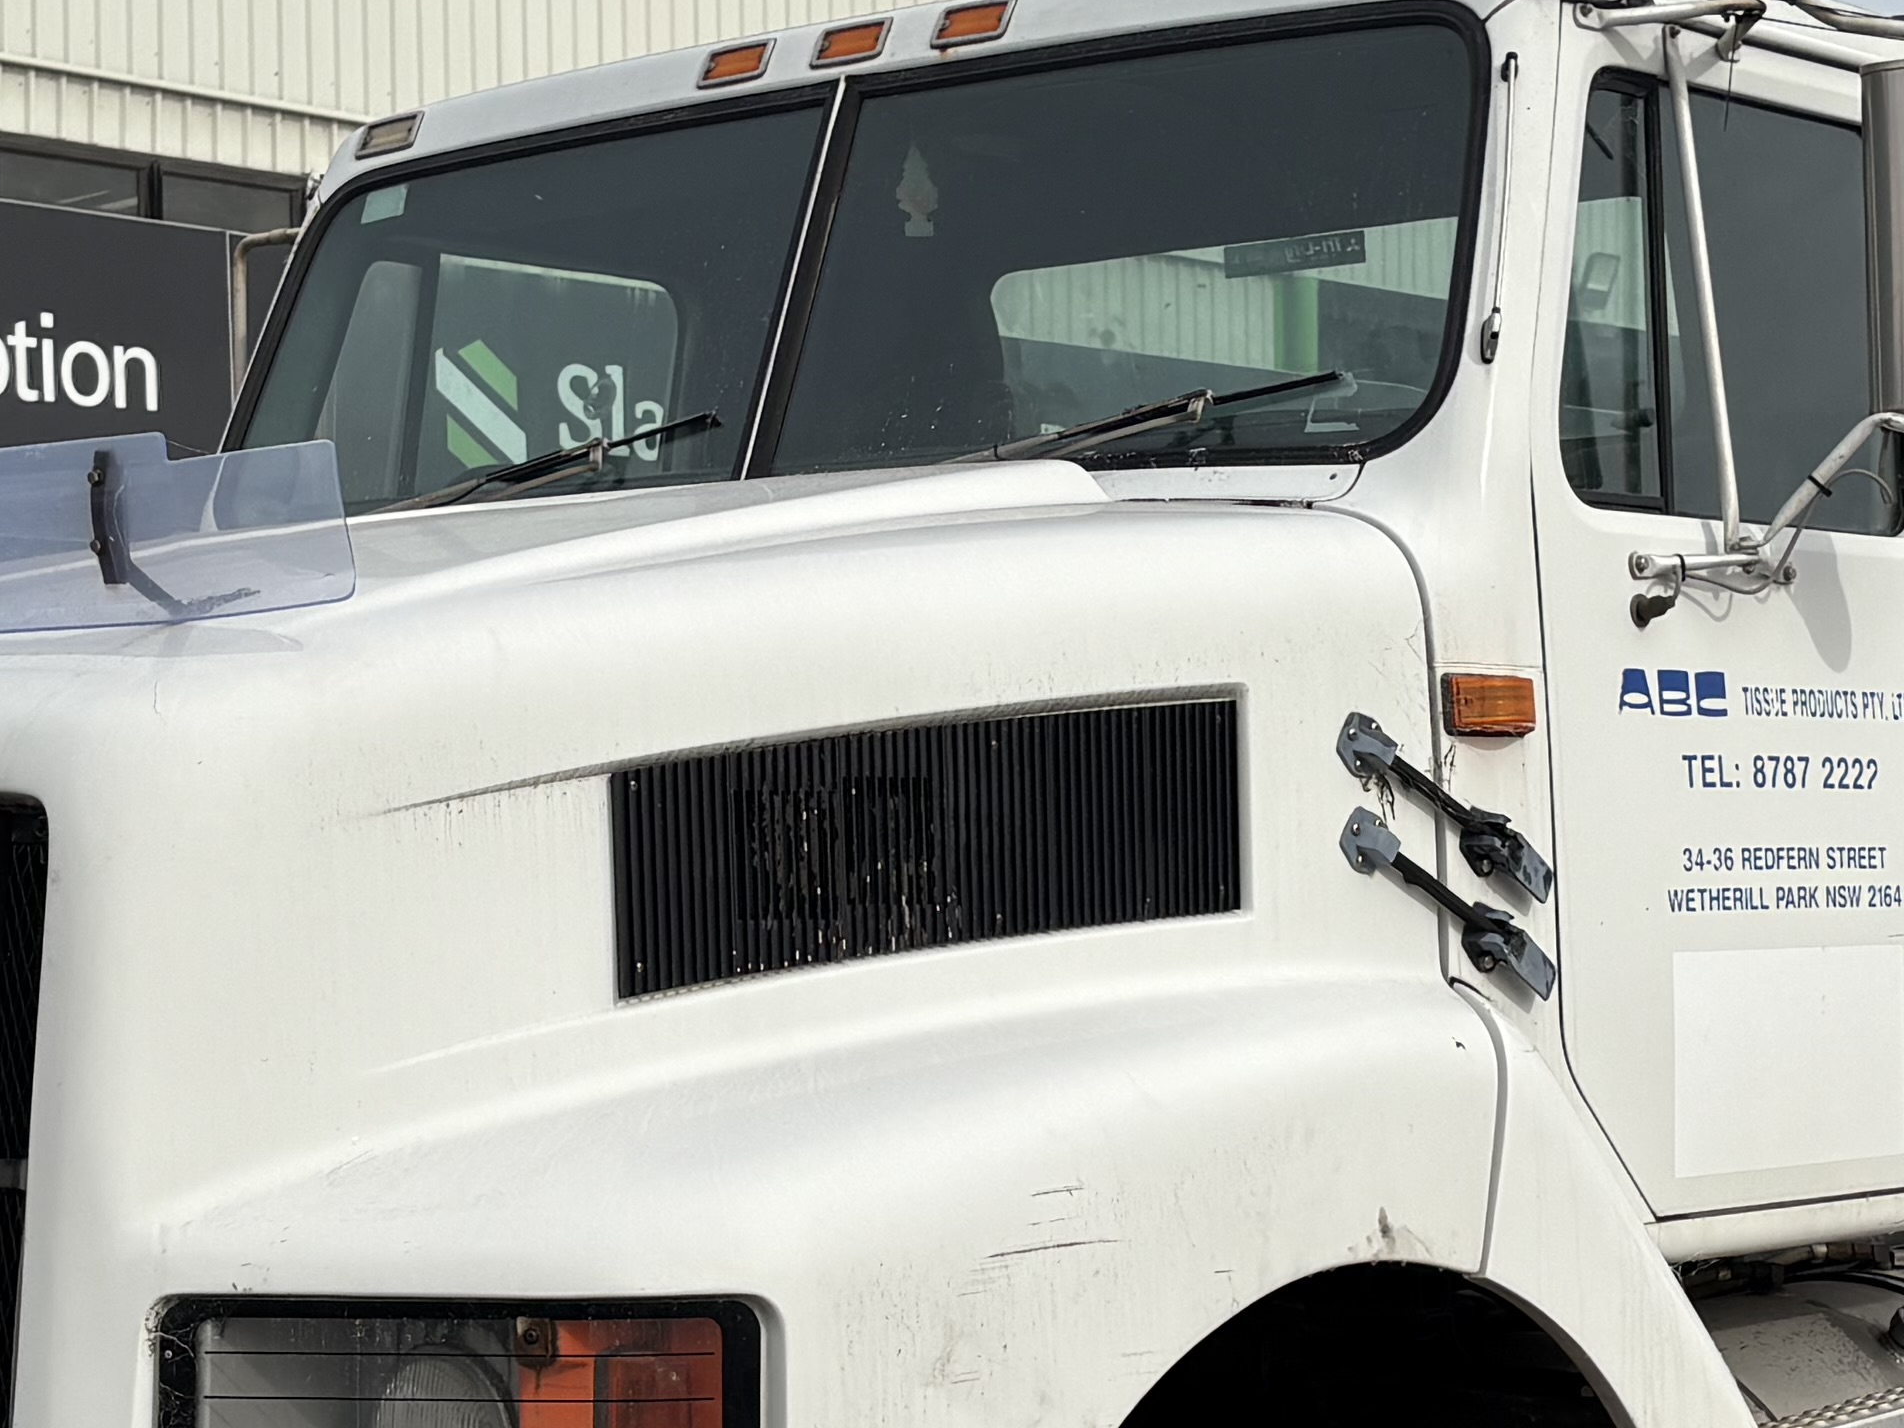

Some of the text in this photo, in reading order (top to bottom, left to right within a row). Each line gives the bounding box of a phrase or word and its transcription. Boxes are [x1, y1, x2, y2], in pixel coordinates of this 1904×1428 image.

[1618, 667, 1728, 718] ABC
[1792, 688, 1859, 720] PRODUCTS
[1682, 754, 1741, 789] TEL:
[1752, 755, 1810, 790] 8787
[1683, 846, 1887, 872] 34-36 REDFERN STREET
[1667, 884, 1903, 913] WETHERILL PARK NSW 2164
